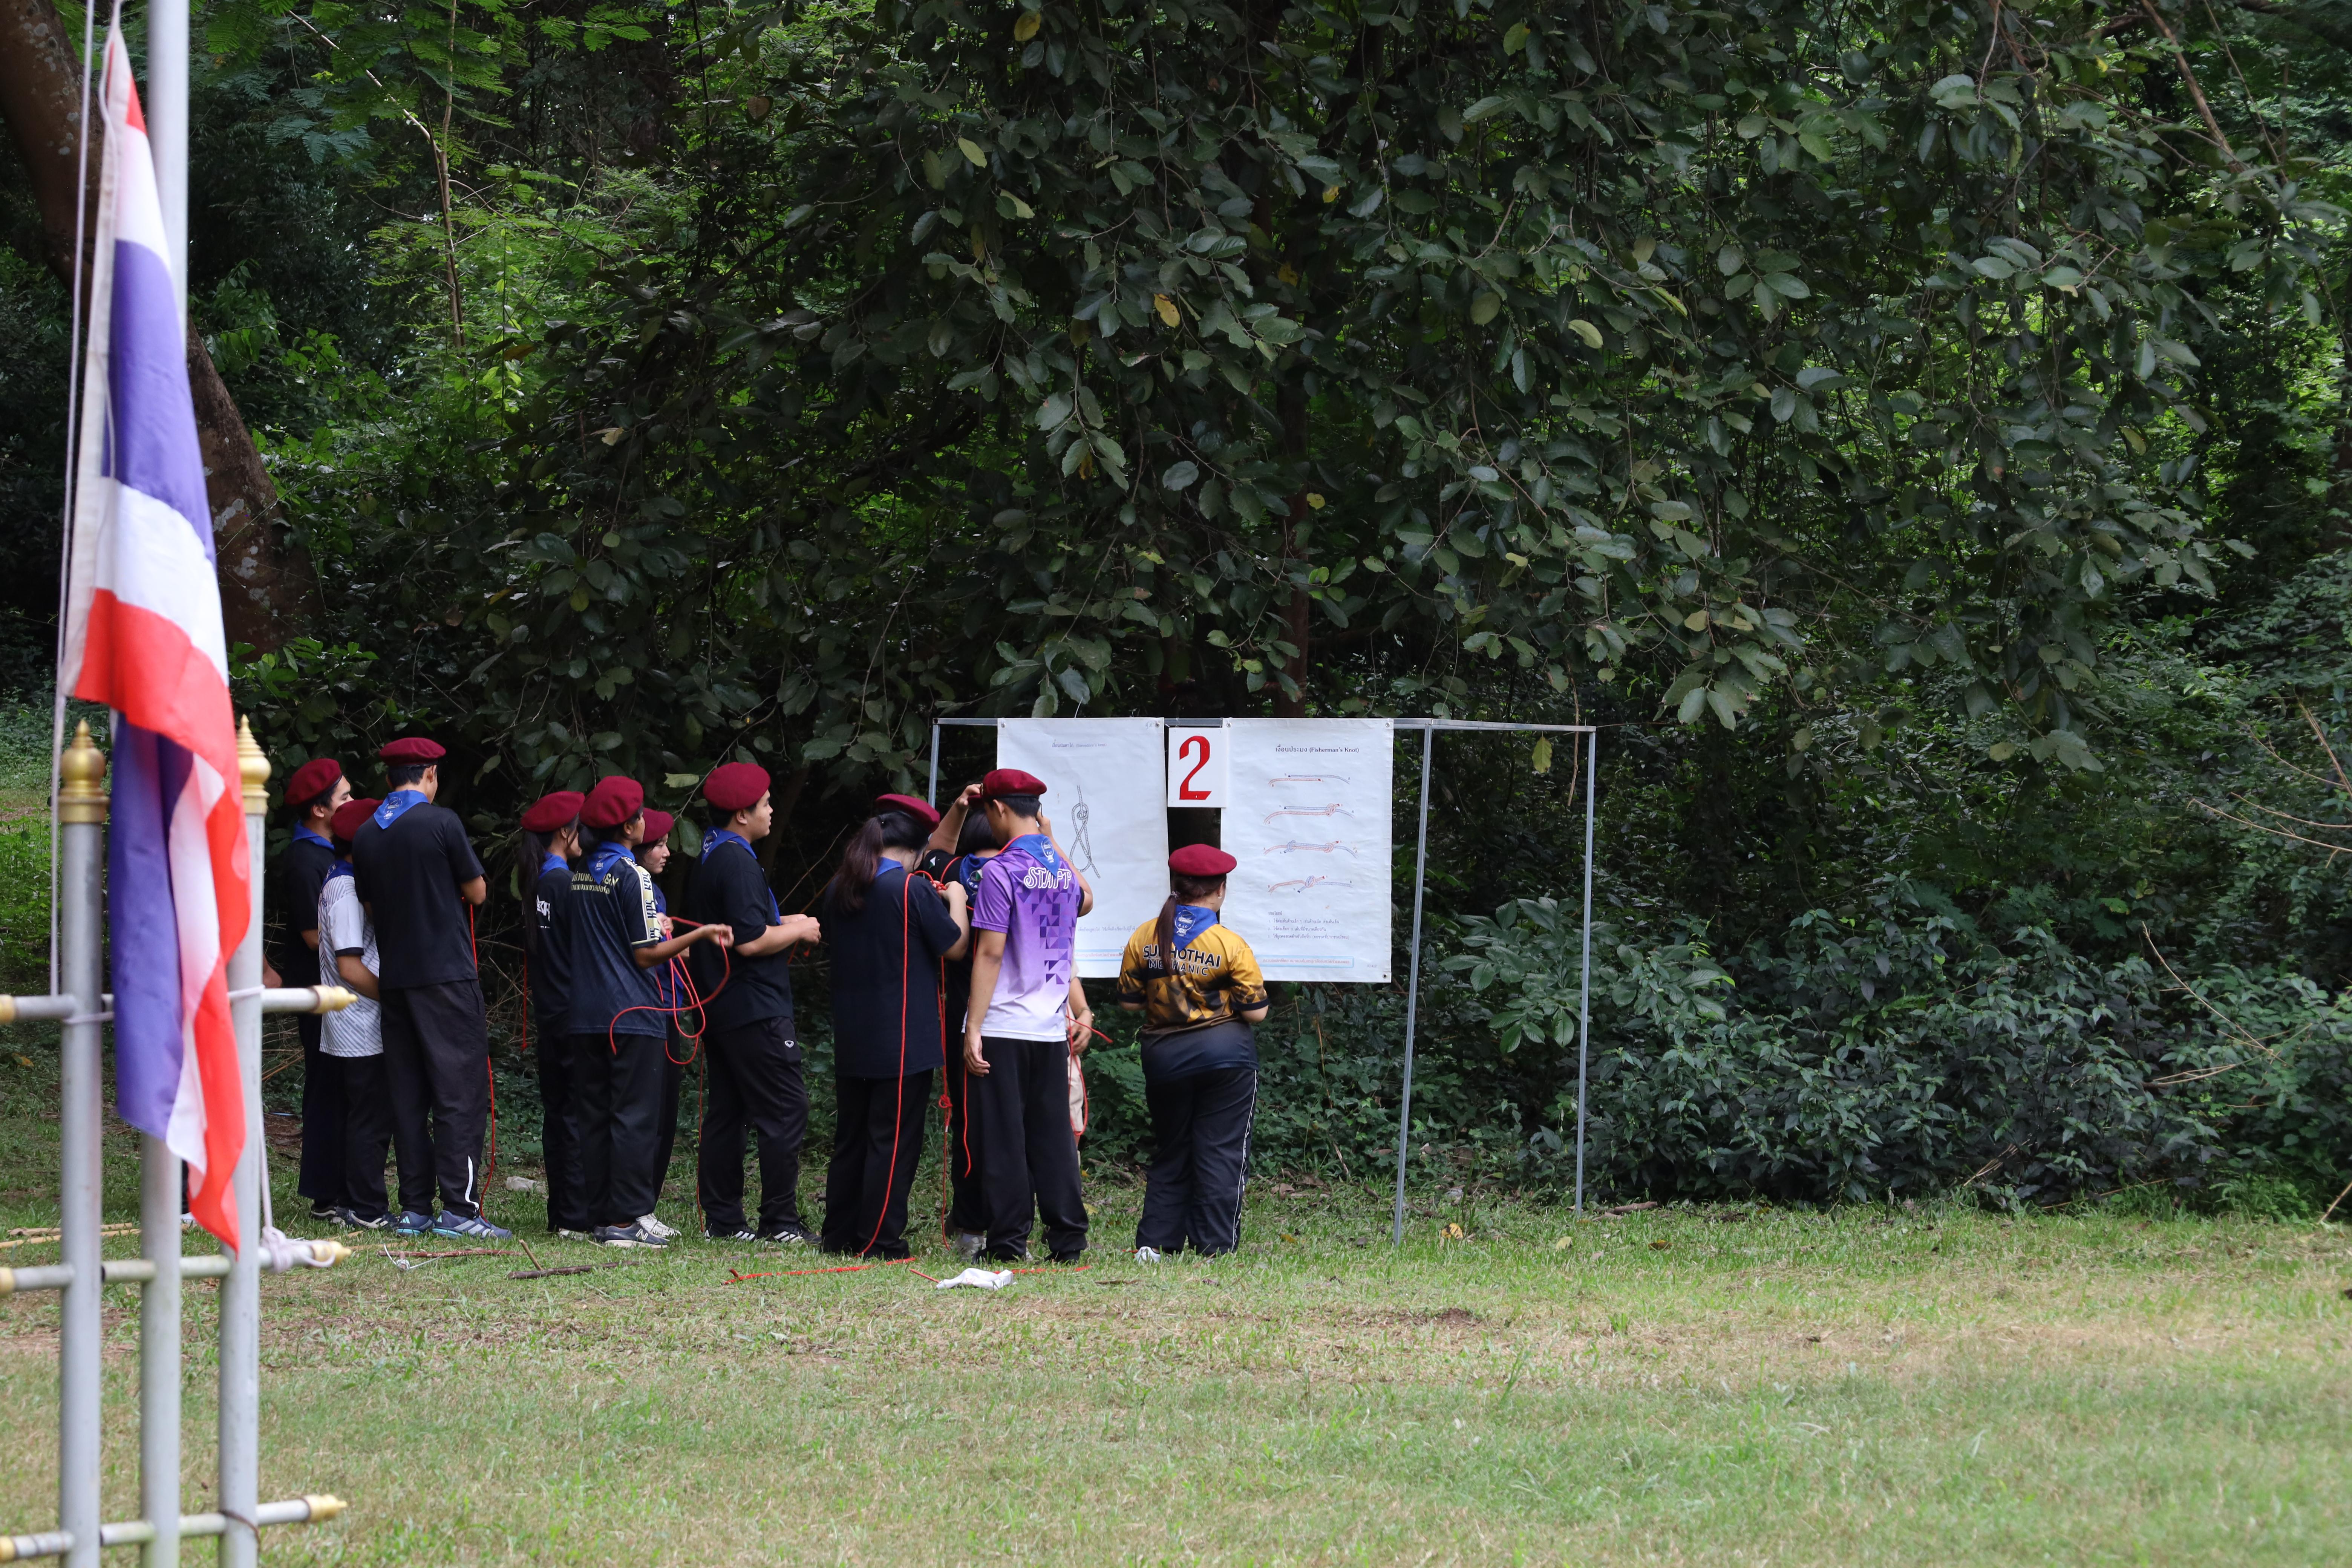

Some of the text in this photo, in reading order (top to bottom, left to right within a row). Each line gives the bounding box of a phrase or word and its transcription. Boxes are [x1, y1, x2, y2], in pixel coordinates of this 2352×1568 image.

[1179, 736, 1212, 800] 2
[1024, 867, 1072, 889] STAFF
[1143, 944, 1221, 968] SUHOTHAI
[1149, 959, 1208, 976] MEHANIC
